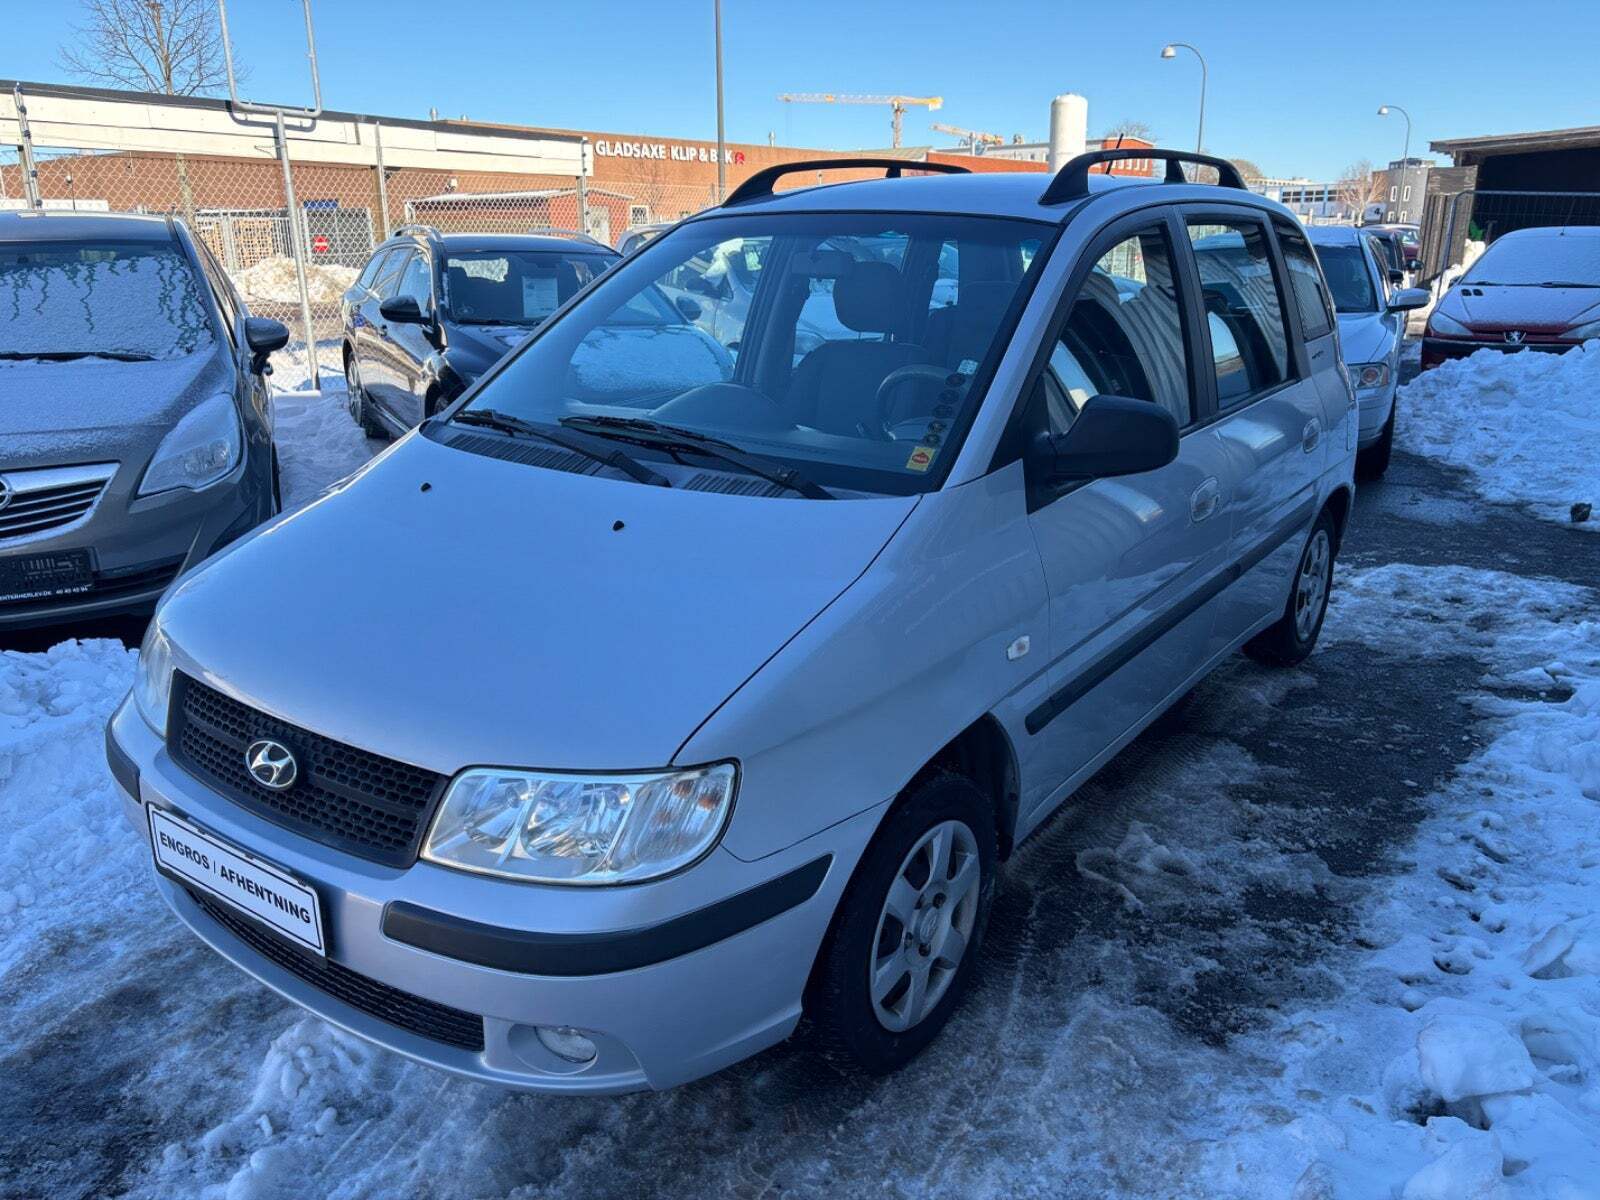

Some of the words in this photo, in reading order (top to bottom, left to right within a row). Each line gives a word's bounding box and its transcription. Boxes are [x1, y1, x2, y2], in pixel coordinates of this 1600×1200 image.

[595, 140, 666, 159] GLADSAXE
[671, 145, 697, 161] KLIP
[710, 148, 733, 164] BK
[160, 831, 210, 870] ENGROS
[220, 865, 311, 924] AFHENTNING
